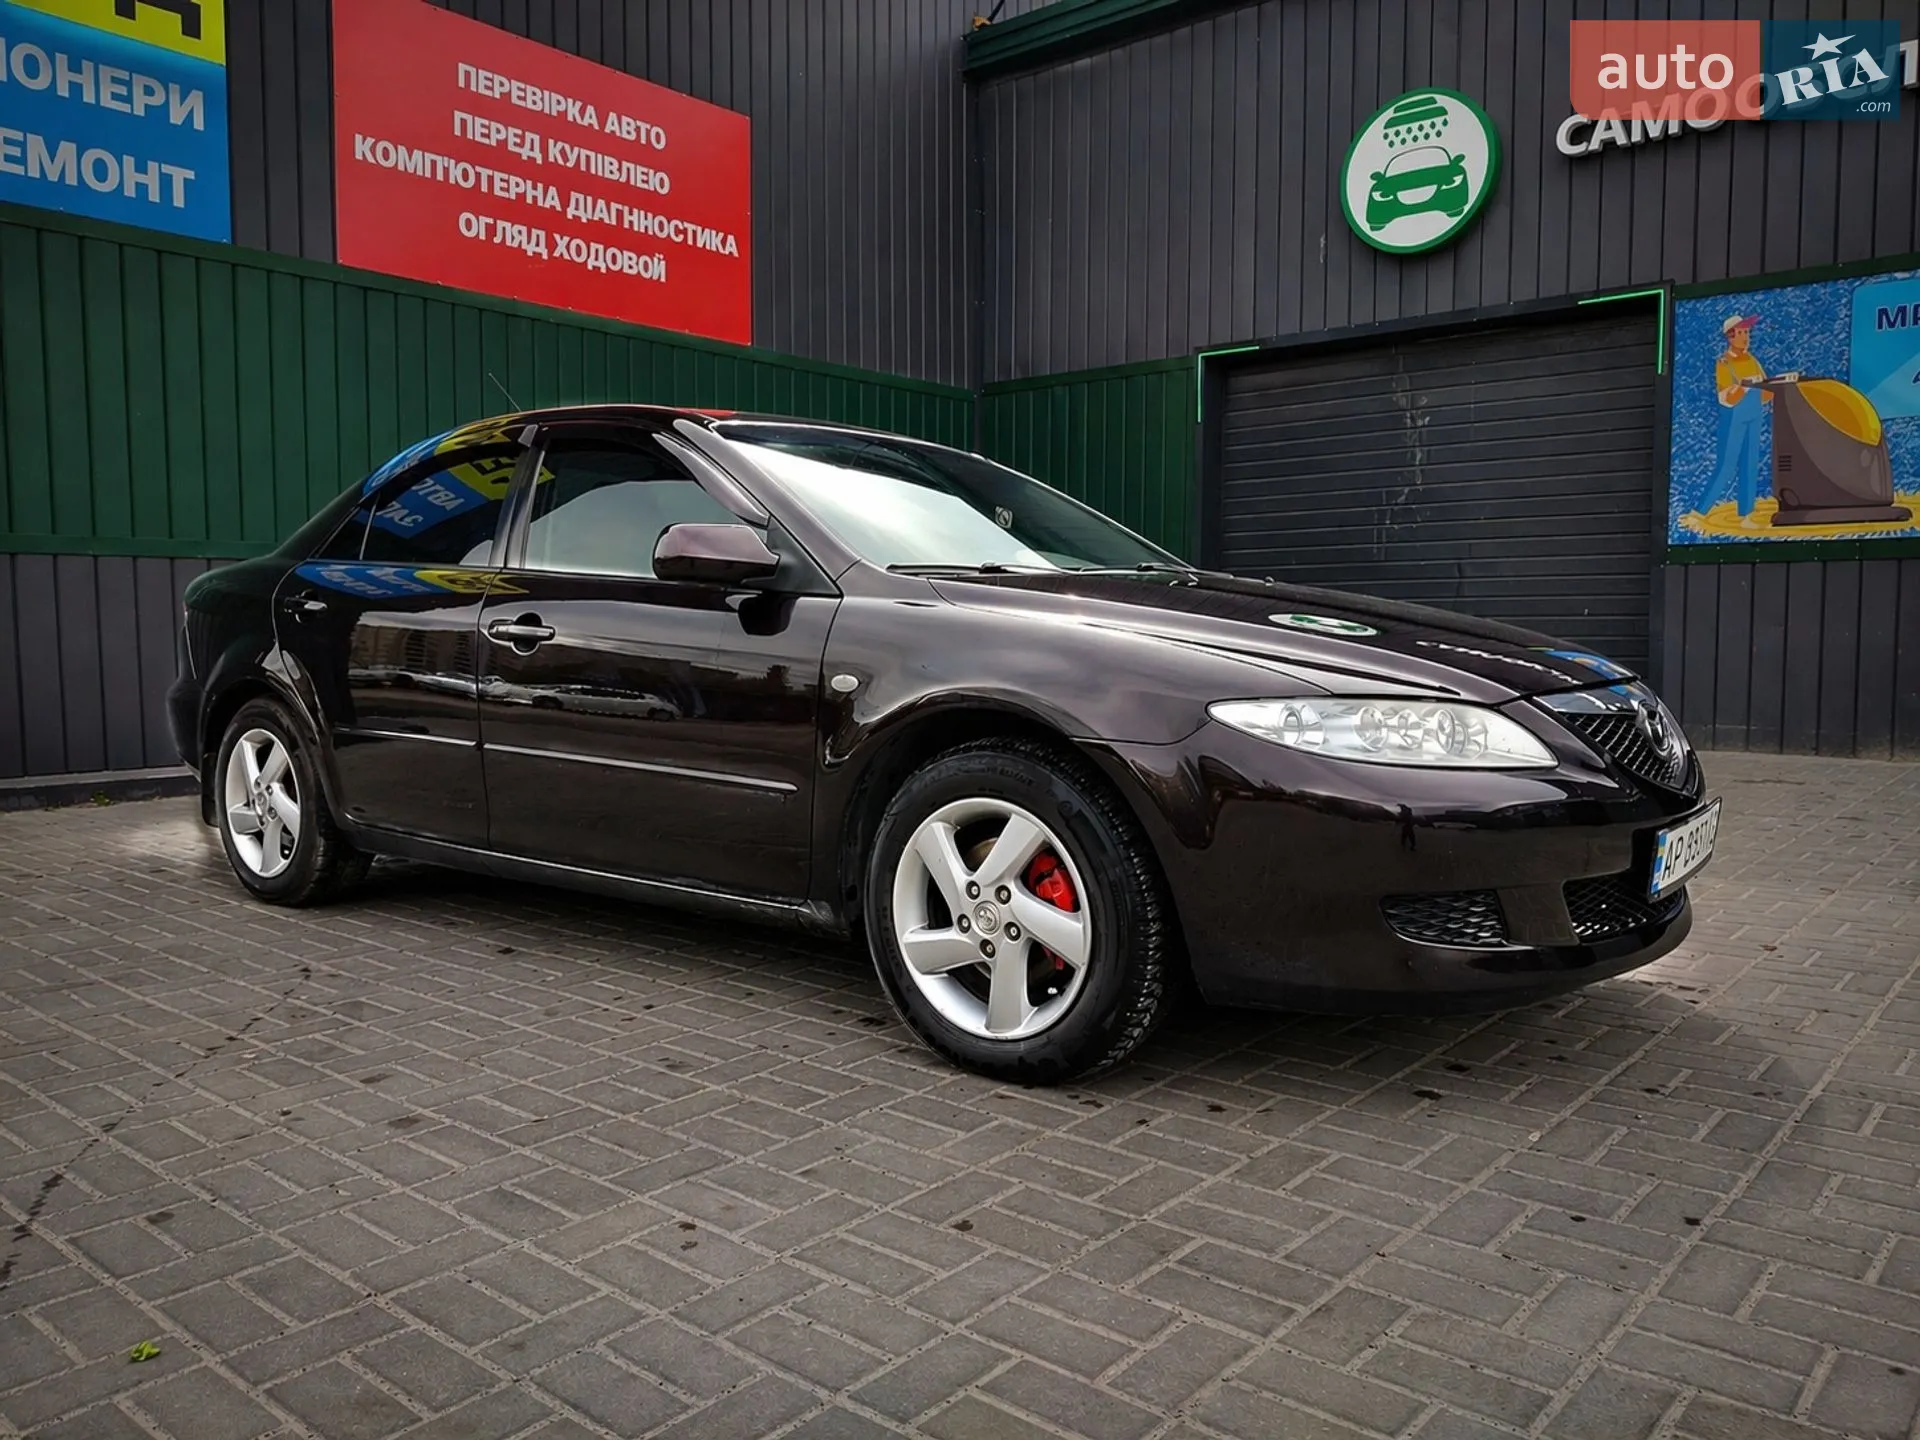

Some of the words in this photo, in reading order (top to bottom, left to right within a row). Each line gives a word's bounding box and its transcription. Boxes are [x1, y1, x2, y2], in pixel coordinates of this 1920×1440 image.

[458, 62, 600, 130] ПЕРЕВІРКА
[604, 111, 667, 150] АВТО
[0, 126, 195, 208] ЕМОНТ
[355, 133, 562, 212] КОМП'ЮТЕРНА
[567, 190, 740, 257] ДІАГННОСТИКА
[453, 110, 543, 164] ПЕРЕД
[548, 138, 671, 195] КУПІВЛЕЮ
[458, 212, 549, 260] ОГЛЯД
[552, 233, 667, 283] ХОДОВОЙ
